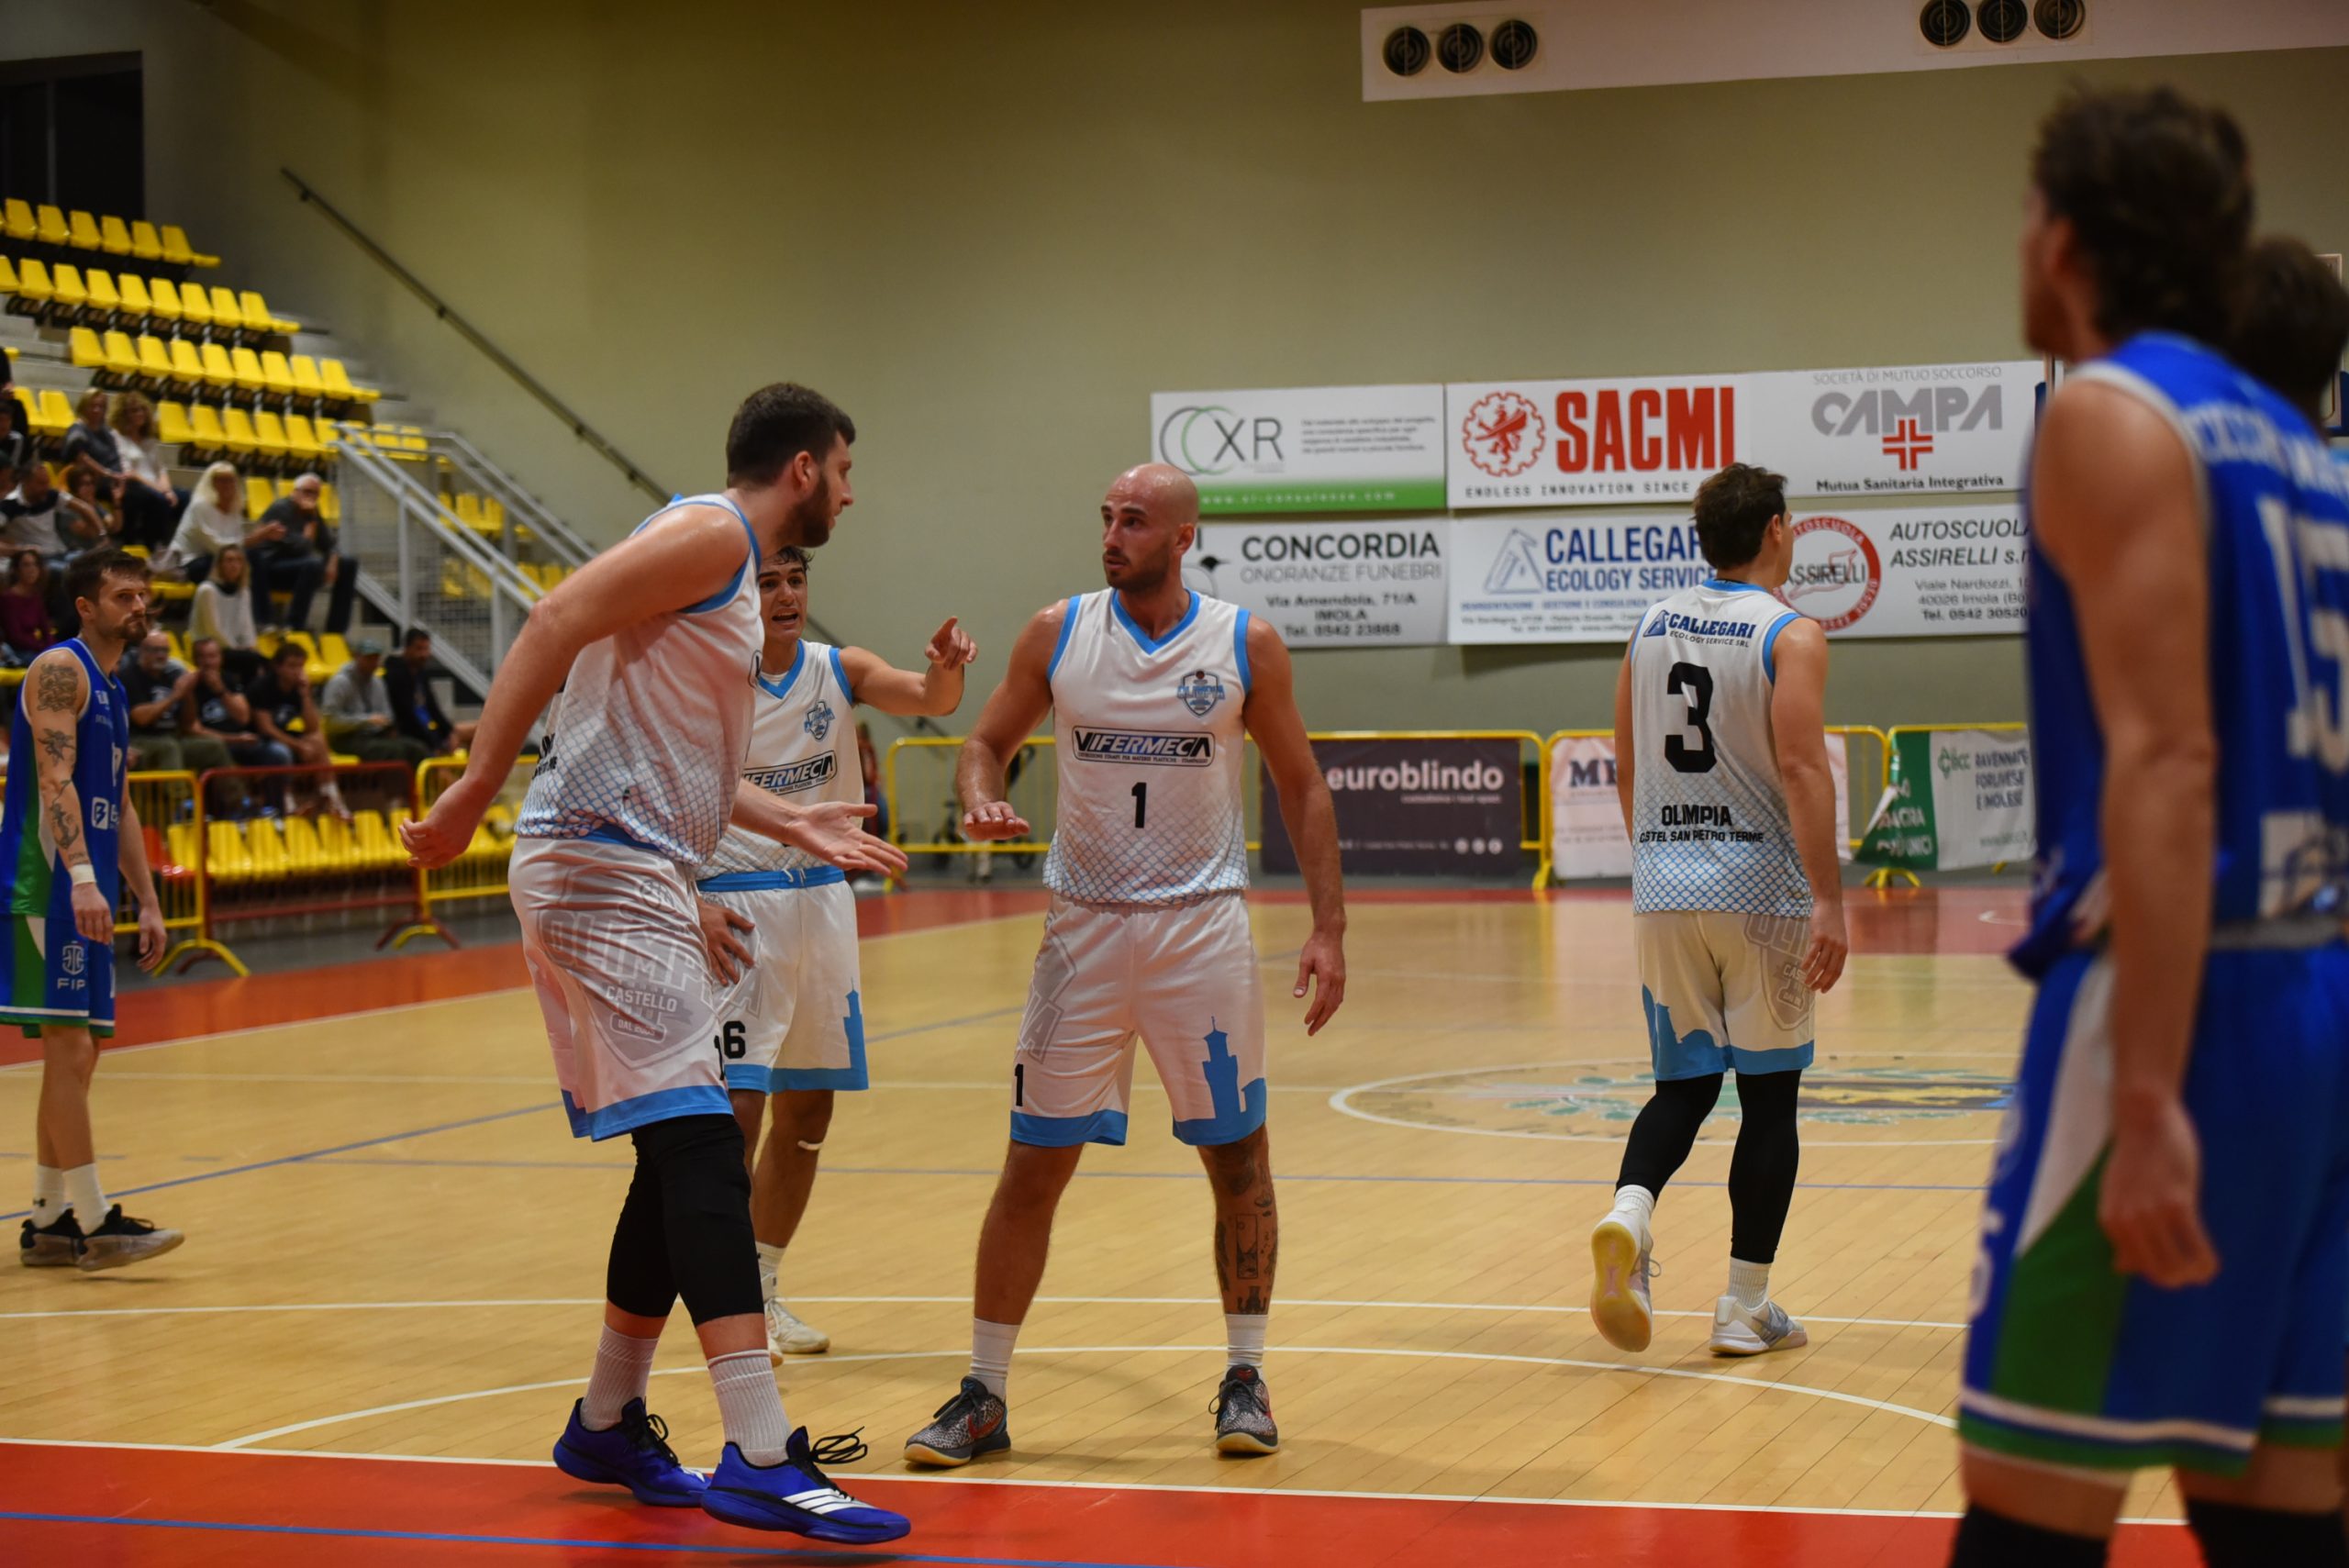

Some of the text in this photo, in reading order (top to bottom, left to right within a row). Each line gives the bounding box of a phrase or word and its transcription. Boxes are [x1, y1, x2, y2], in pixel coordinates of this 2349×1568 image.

[1883, 369, 1930, 383] MUTUO
[1932, 366, 2002, 381] SOCCORSO
[1811, 384, 2003, 437] CAMPA
[1555, 386, 1734, 473] SACMI
[1465, 481, 1689, 498] ENDLESS INNOVATION SINCE
[1816, 473, 2004, 493] Mutua Sanitaria Integrativa
[1241, 532, 1441, 562] CONCORDIA
[1889, 546, 1998, 568] ASSIRELLI
[1240, 562, 1442, 584] ONORANZE FUNEBRI
[1547, 569, 1632, 593] ECOLOGY
[1915, 579, 1947, 592] Viale
[1265, 595, 1290, 607] Via
[1962, 593, 1998, 606] Imola
[1314, 609, 1367, 621] IMOLA
[1948, 607, 1983, 621] 0542
[1668, 613, 1757, 639] CALLEGARI
[1669, 630, 1750, 648] ECOLOGY SERVICE SRL
[1664, 661, 1717, 773] 3
[1074, 730, 1211, 758] VIFERMECA
[1327, 759, 1504, 792] euroblindo
[1131, 782, 1147, 829] 1
[1662, 804, 1733, 827] OLIMPIA
[1670, 829, 1690, 842] SAN
[1729, 831, 1765, 843] TERME
[57, 978, 86, 991] FIP
[606, 984, 678, 1013] CASTELLO
[1014, 1063, 1024, 1107] 1
